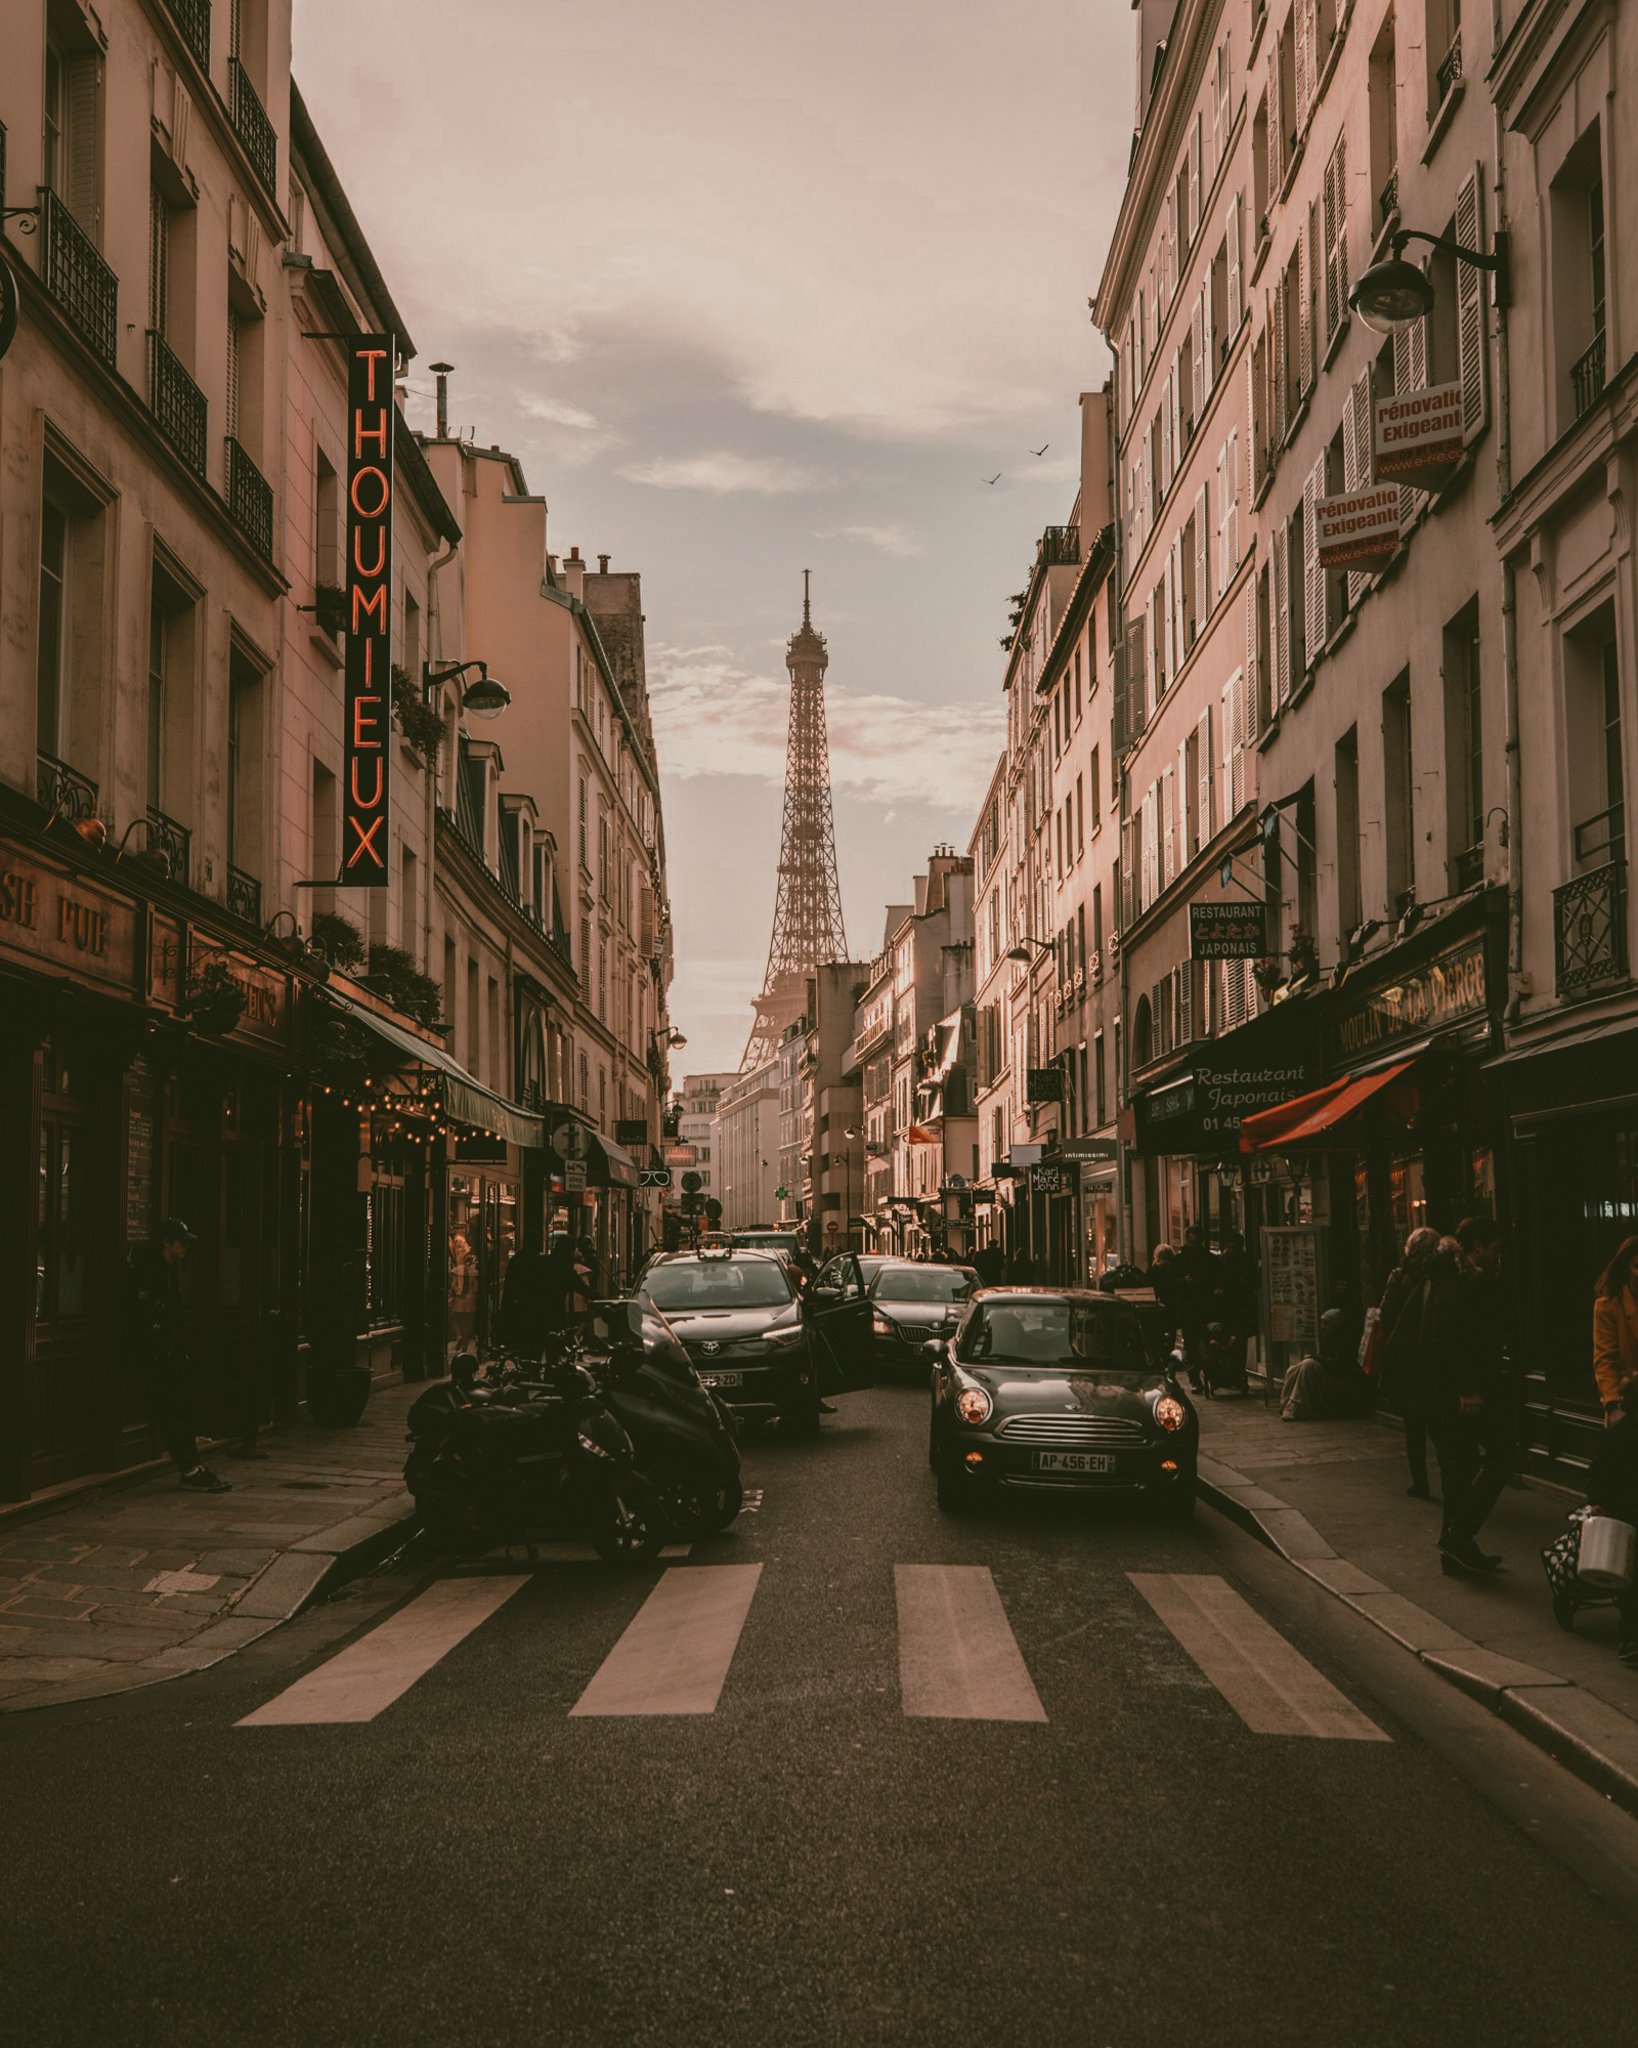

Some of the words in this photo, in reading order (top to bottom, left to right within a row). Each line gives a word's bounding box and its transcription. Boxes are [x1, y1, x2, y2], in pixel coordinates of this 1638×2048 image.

[1383, 409, 1463, 443] Exigeant
[347, 349, 390, 869] THOUMIEUX
[1192, 905, 1261, 919] RESTAURANT
[1199, 942, 1257, 955] JAPONAIS
[1340, 1006, 1382, 1052] MOULIN
[1196, 1065, 1305, 1085] Restaurant
[1208, 1087, 1296, 1110] Japonais
[1203, 1117, 1218, 1130] 01
[1224, 1116, 1241, 1129] 45
[1037, 1166, 1059, 1176] Karl
[1033, 1175, 1060, 1183] Marc
[1034, 1183, 1060, 1191] John
